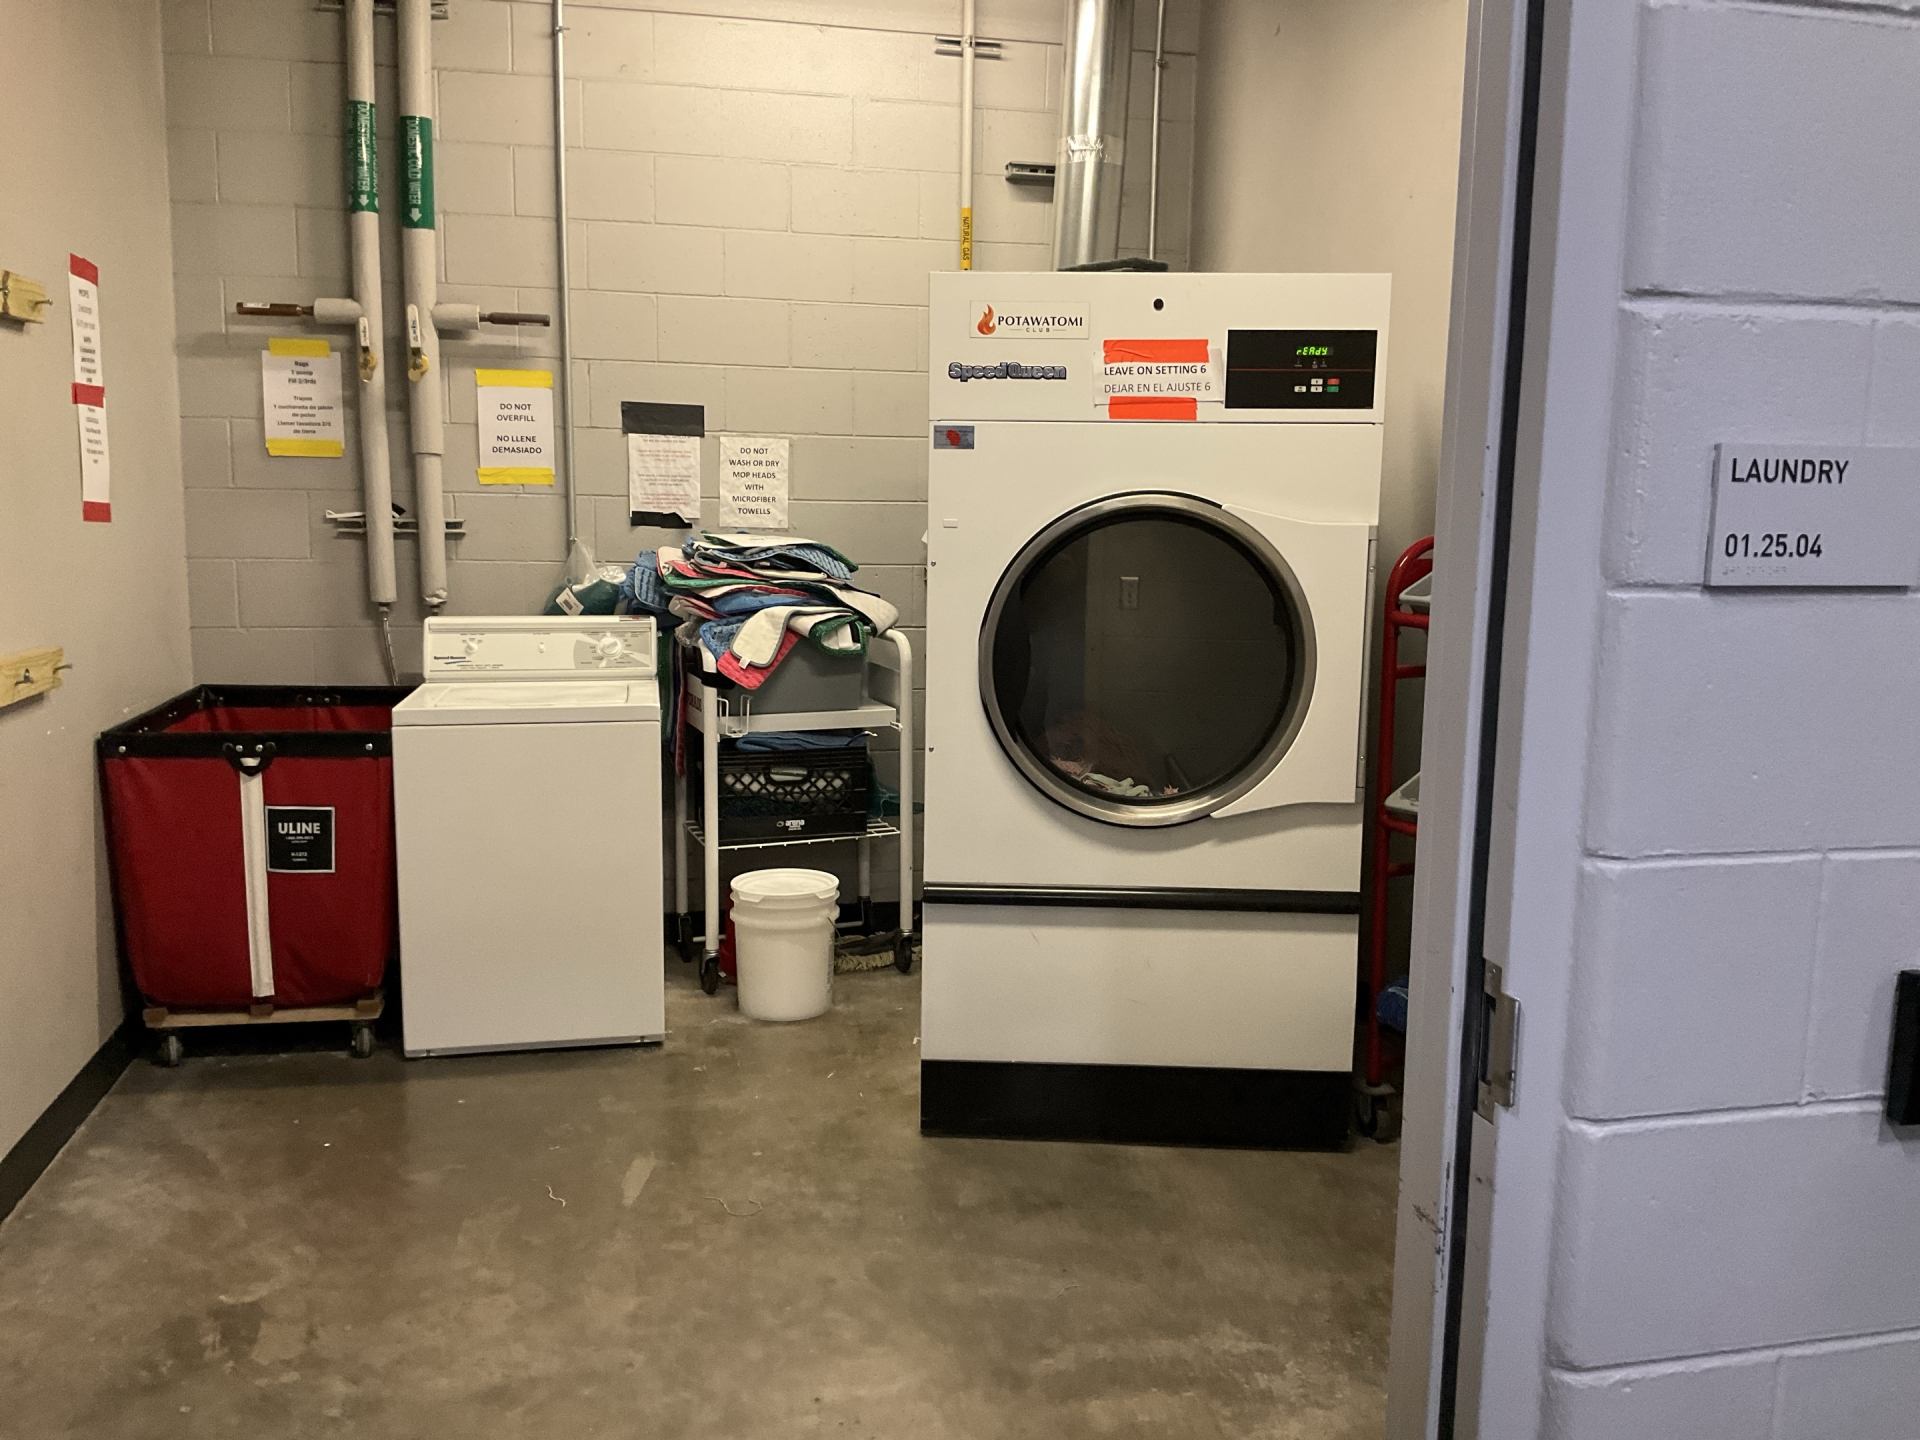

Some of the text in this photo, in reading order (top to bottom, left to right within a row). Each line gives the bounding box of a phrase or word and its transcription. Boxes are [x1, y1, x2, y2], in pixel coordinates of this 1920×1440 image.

[357, 104, 370, 145] DOMESTIC
[357, 166, 370, 191] WATER
[409, 181, 422, 204] WATER
[962, 216, 970, 261] NATURAL GAS
[997, 315, 1083, 327] POTAWATOMI
[948, 361, 1067, 382] Speed Queen
[1104, 364, 1207, 376] LEAVE ON SETTING 6
[1104, 382, 1211, 394] DEJAR EN EL AJUSTE 6
[499, 403, 532, 411] DO NOT
[496, 414, 536, 422] OVERFILL
[496, 435, 537, 443] NO LLENE
[492, 446, 542, 454] DEMASIADO
[740, 447, 769, 455] DO NOT
[728, 459, 751, 467] WASH
[752, 459, 764, 467] OR
[1731, 457, 1850, 484] LAUNDRY
[732, 495, 777, 503] MICROFIBER
[737, 507, 771, 515] TOWELLS
[1724, 533, 1823, 558] 01.25.04
[277, 822, 321, 835] ULINE
